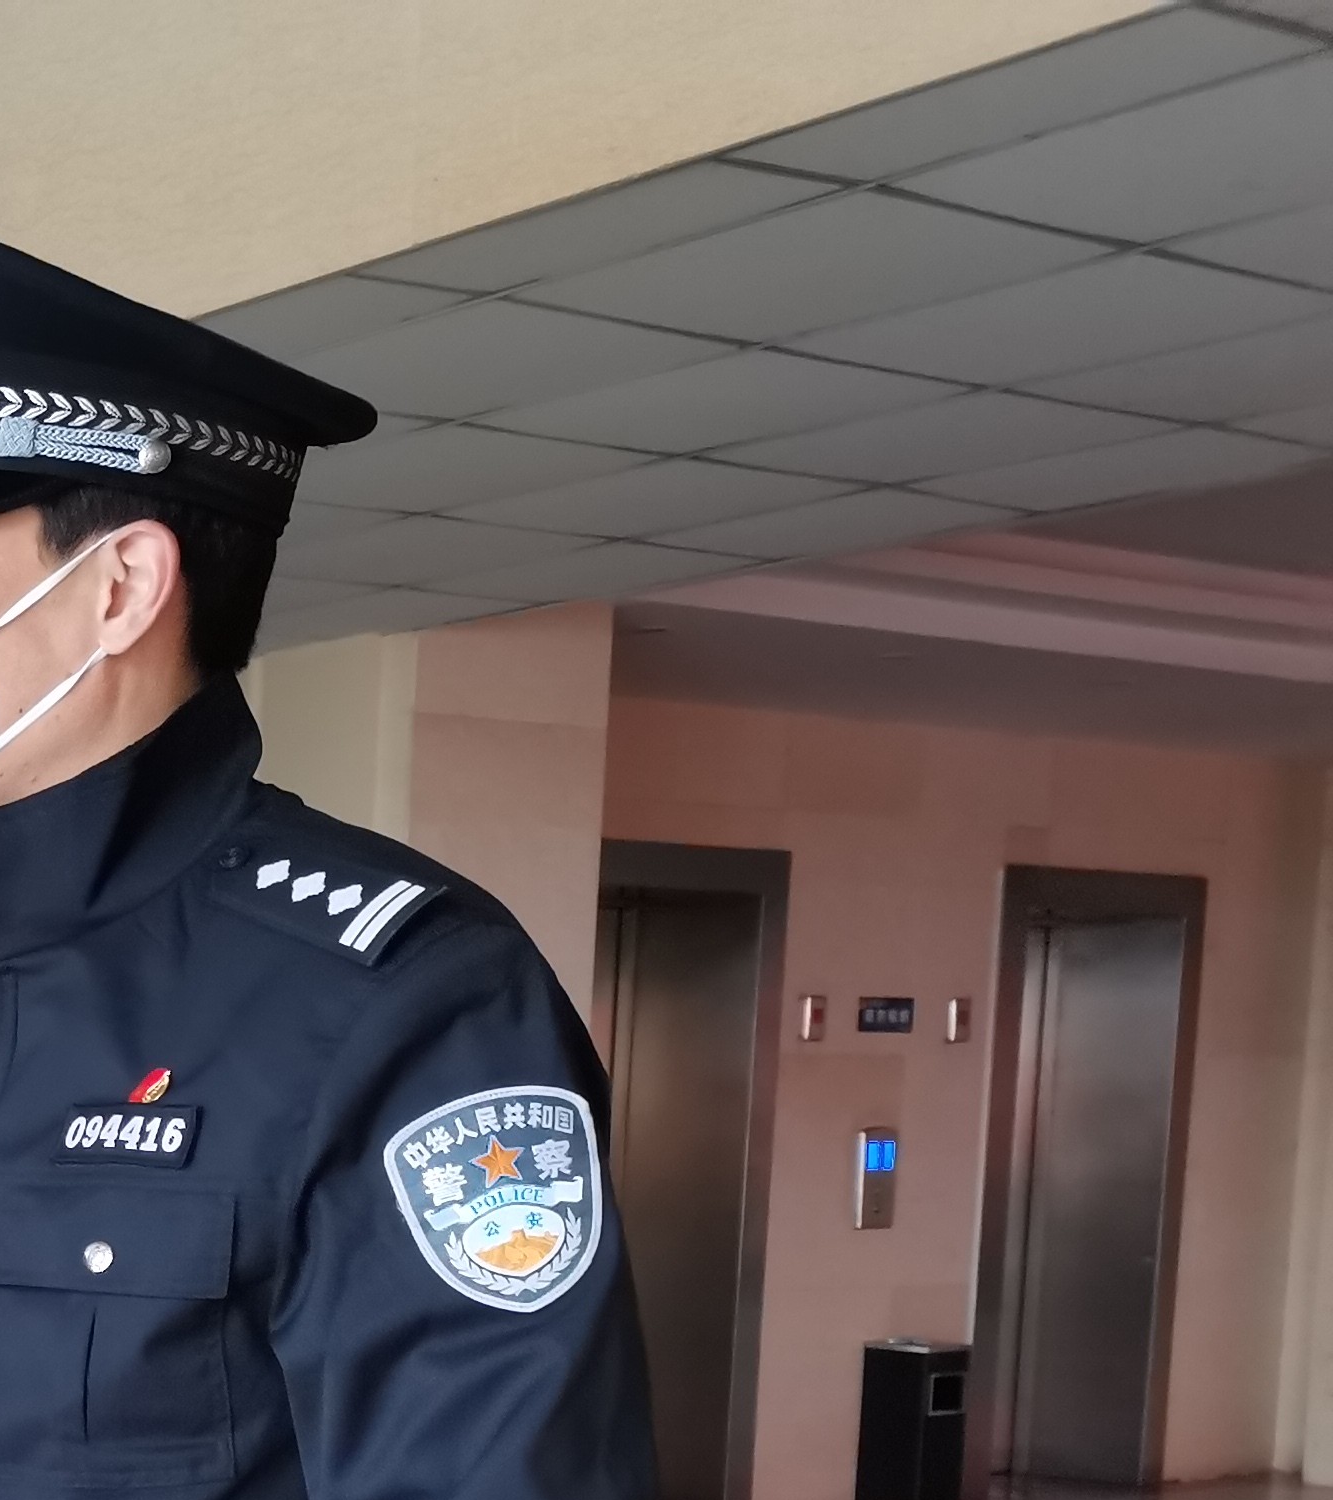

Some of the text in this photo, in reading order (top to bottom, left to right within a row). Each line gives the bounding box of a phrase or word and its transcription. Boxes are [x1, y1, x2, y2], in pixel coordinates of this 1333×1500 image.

[65, 1114, 187, 1153] 094416
[403, 1102, 574, 1170] 中华人民共和国
[469, 1187, 545, 1215] POLICE
[484, 1210, 544, 1237] 公安
